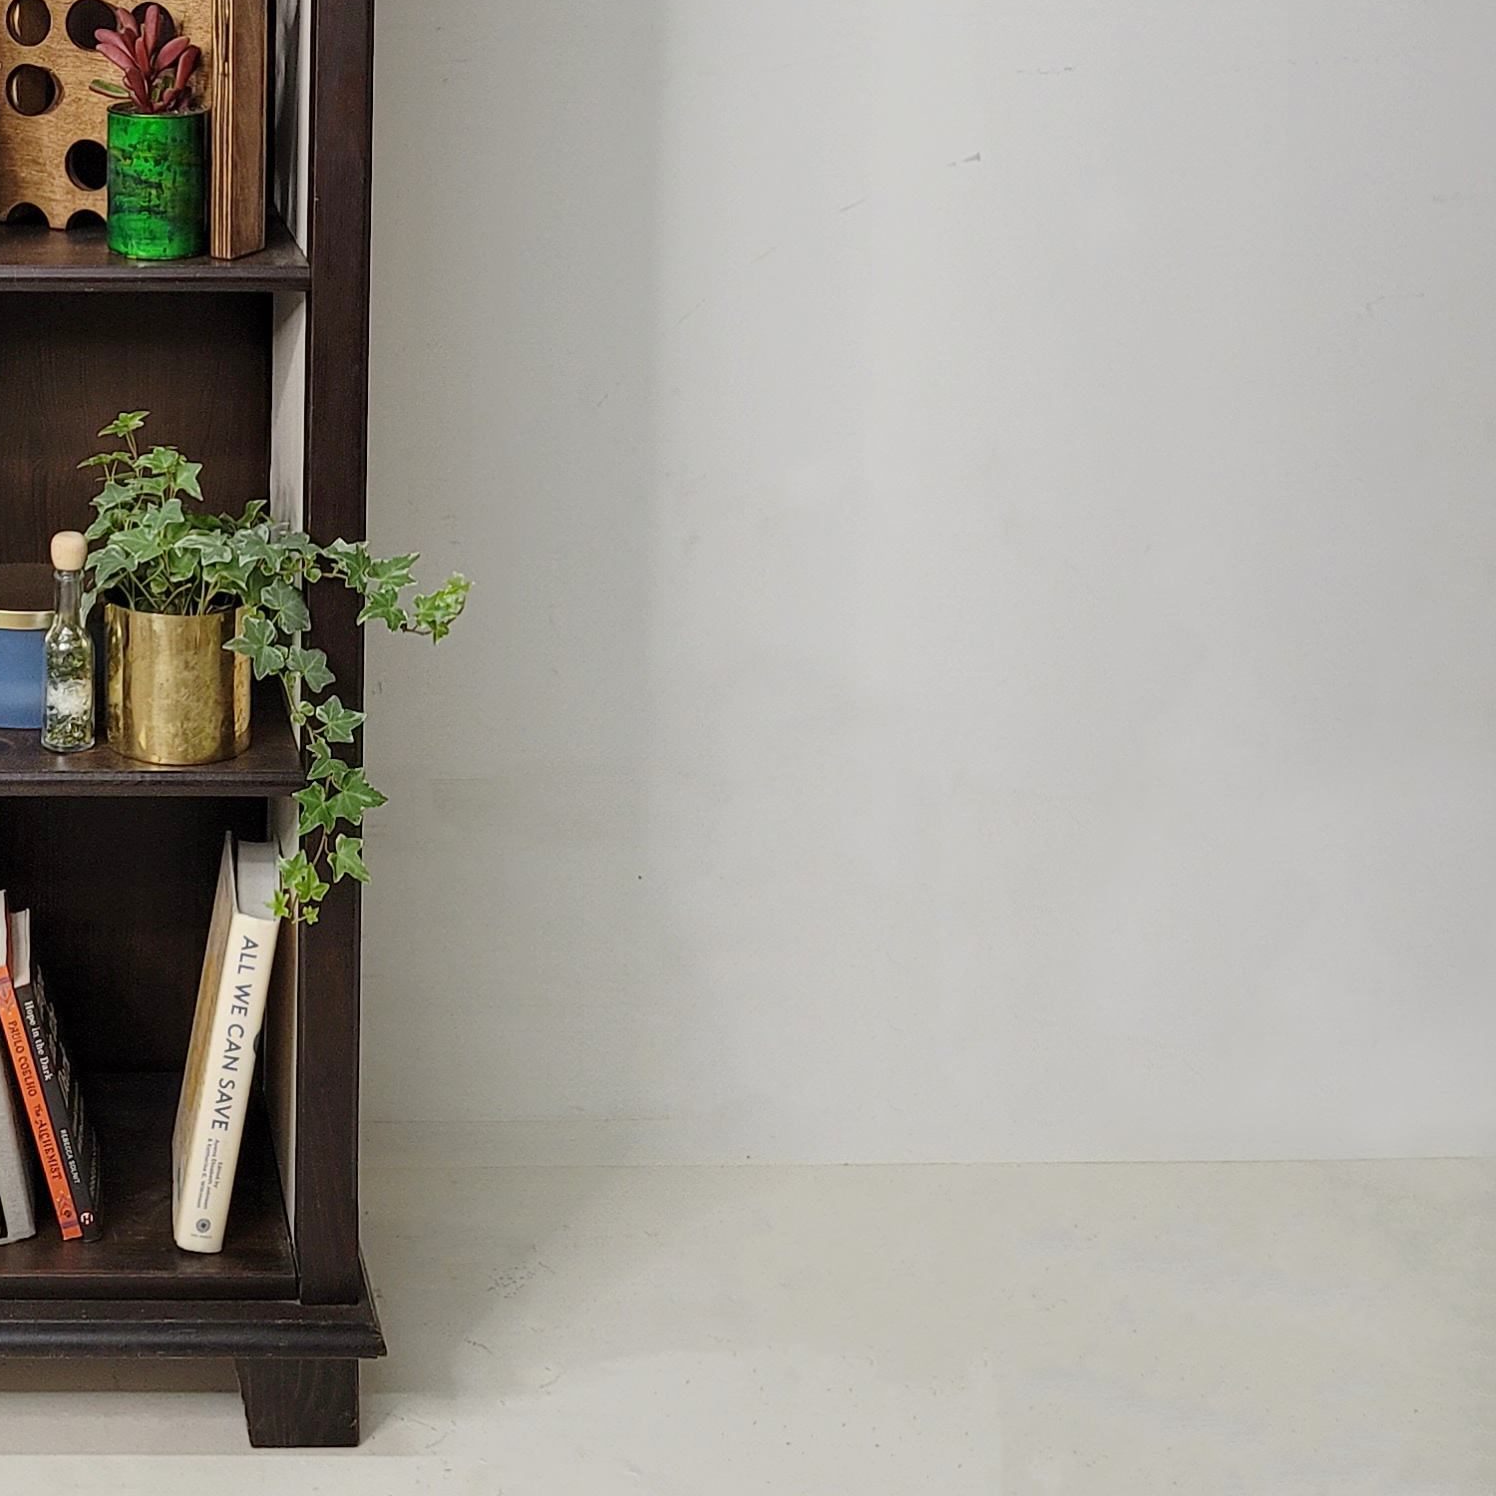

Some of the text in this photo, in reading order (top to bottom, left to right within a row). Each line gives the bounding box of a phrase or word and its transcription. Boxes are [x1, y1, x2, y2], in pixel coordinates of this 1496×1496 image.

[24, 1000, 36, 1026] Hope
[31, 1026, 41, 1039] in
[34, 1038, 45, 1055] the
[211, 934, 259, 1132] ALL WE CAN SAVE
[8, 1019, 38, 1097] PAULO COELHO
[39, 1055, 54, 1082] Dark
[34, 1119, 63, 1180] ALCHEMIST
[59, 1128, 74, 1160] REBECCA
